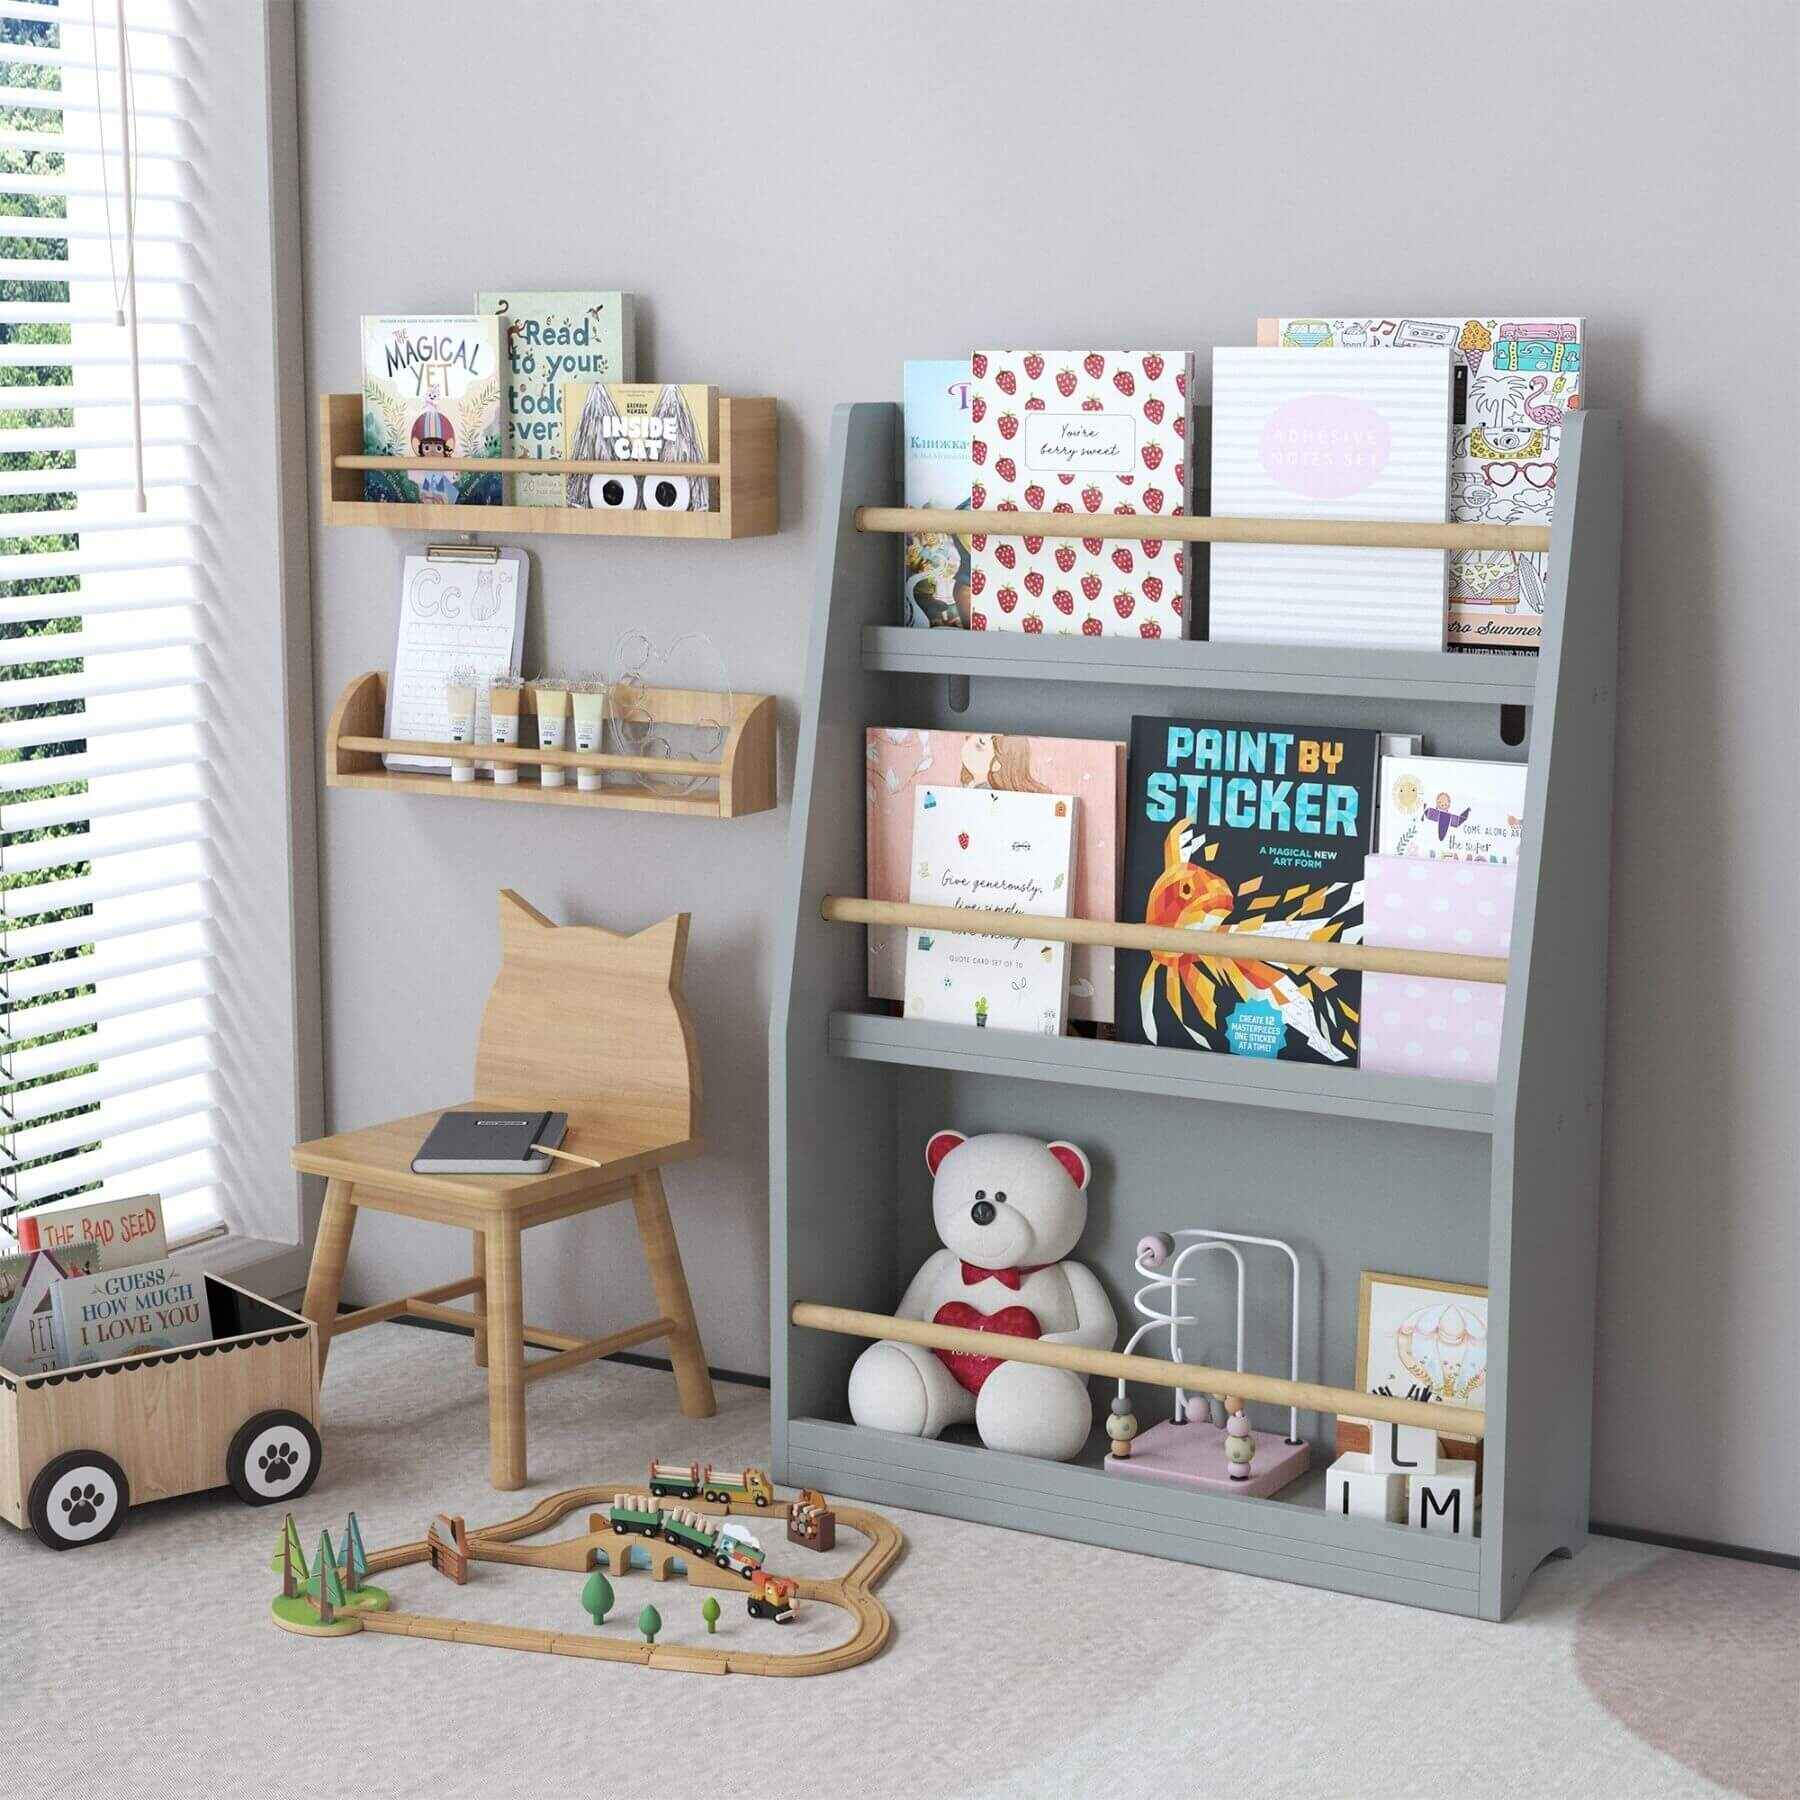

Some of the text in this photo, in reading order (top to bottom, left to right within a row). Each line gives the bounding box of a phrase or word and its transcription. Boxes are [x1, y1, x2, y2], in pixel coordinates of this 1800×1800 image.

[392, 328, 408, 344] THE
[526, 318, 589, 345] Read
[385, 336, 479, 377] MAGICAL
[511, 346, 602, 382] to your
[410, 363, 451, 396] YET
[508, 422, 563, 440] ver
[603, 415, 678, 440] INSIDE
[1062, 424, 1100, 439] You're
[614, 438, 662, 459] CAT
[1040, 443, 1120, 461] berry sweet
[1448, 621, 1542, 636] tro Summer
[1166, 726, 1344, 775] PAINT BY
[1146, 771, 1359, 837] STICKER
[1464, 825, 1480, 834] COME
[1485, 827, 1506, 837] ALONG
[1269, 847, 1311, 857] MAGICAL
[1314, 851, 1337, 859] NEW
[1449, 835, 1491, 854] the super
[1273, 857, 1321, 868] ART FORM
[942, 869, 968, 886] Give
[1232, 1023, 1280, 1035] MASTERPIECES
[1240, 1014, 1264, 1024] CREATE
[1234, 1031, 1276, 1044] ONE STICKER
[44, 1208, 156, 1246] THE BAD SEED
[105, 1268, 165, 1295] GUESS
[82, 1284, 193, 1321] HOW MUCH
[81, 1303, 200, 1346] I LOVE YOU
[1391, 1424, 1418, 1467] L
[1420, 1487, 1460, 1533] M
